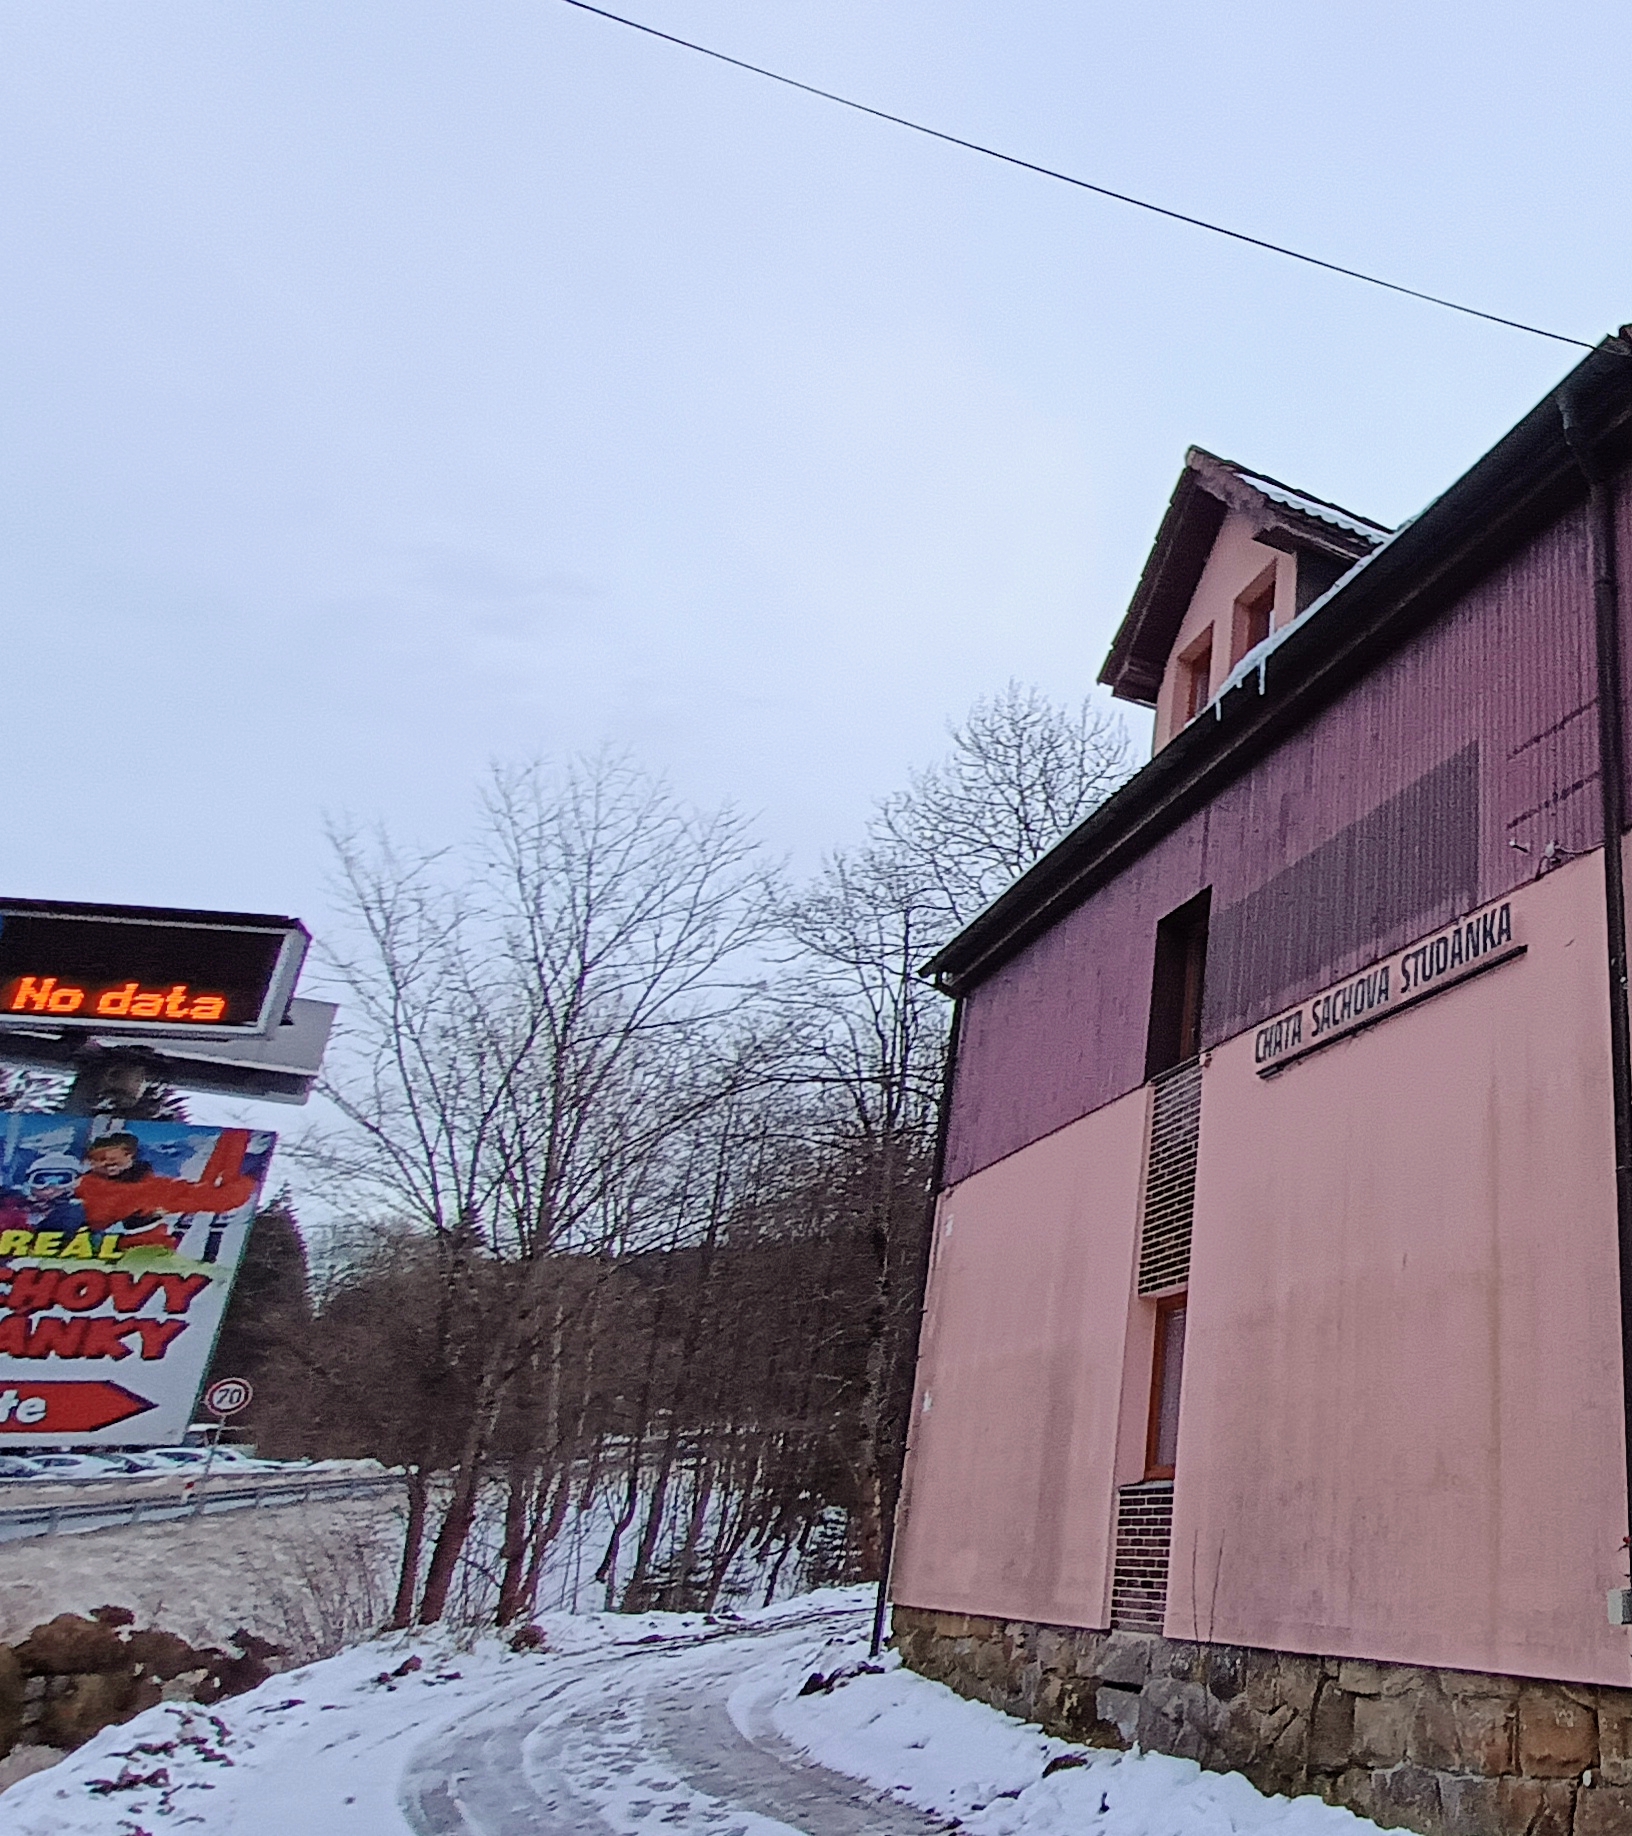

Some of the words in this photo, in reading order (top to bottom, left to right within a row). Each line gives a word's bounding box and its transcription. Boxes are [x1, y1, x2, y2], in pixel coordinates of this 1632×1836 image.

[12, 977, 84, 1013] No
[97, 984, 226, 1021] data
[1255, 1010, 1303, 1063] CHATA
[1312, 965, 1390, 1038] SACHOVA
[216, 1388, 242, 1405] 70
